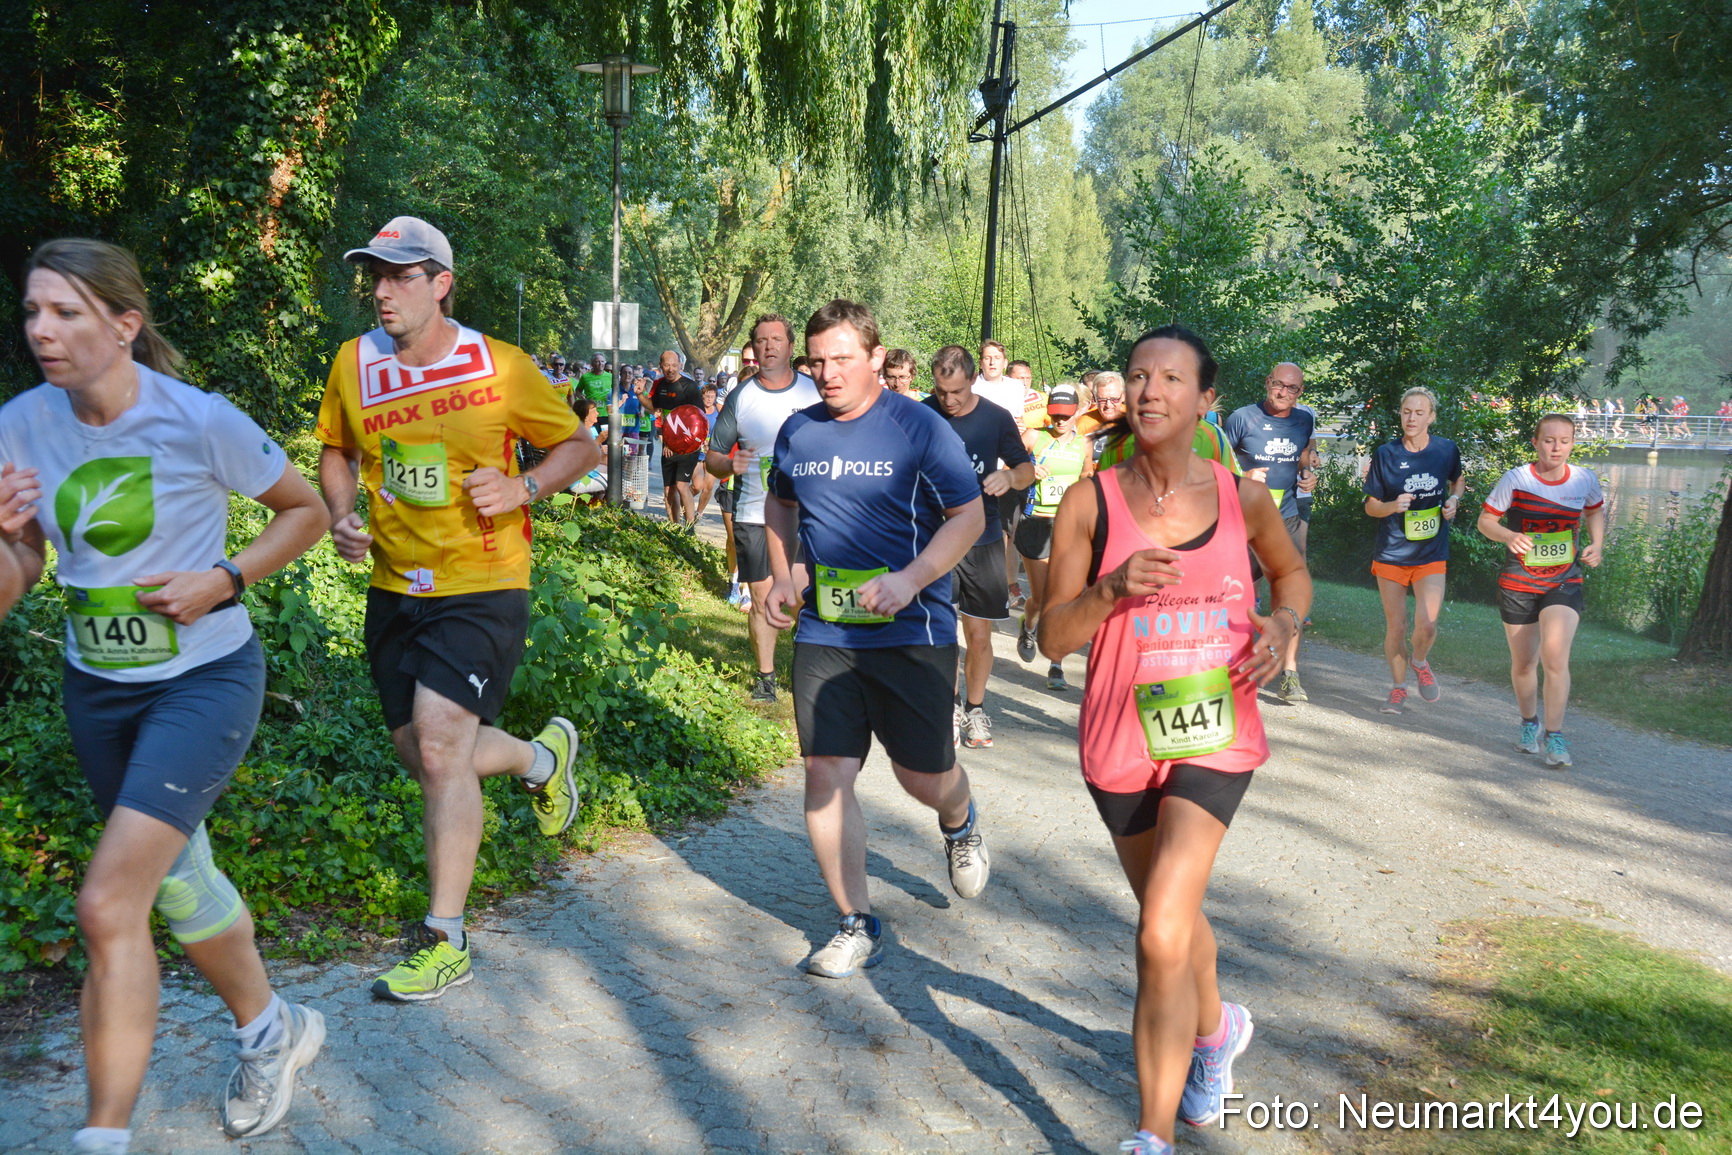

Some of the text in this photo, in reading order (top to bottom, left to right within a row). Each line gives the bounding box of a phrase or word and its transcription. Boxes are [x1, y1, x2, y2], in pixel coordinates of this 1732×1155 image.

[363, 390, 502, 435] MAX BÖGL
[387, 458, 437, 488] 1215
[792, 461, 893, 477] EURO POLES
[1050, 486, 1063, 496] 20
[1414, 519, 1435, 531] 280
[1532, 543, 1567, 556] 1889
[1145, 592, 1199, 612] Pflegen
[84, 616, 147, 645] 140
[1133, 608, 1229, 637] NOVITA
[1152, 697, 1224, 737] 1447
[1171, 736, 1191, 744] Kindt
[1193, 731, 1219, 742] Karola
